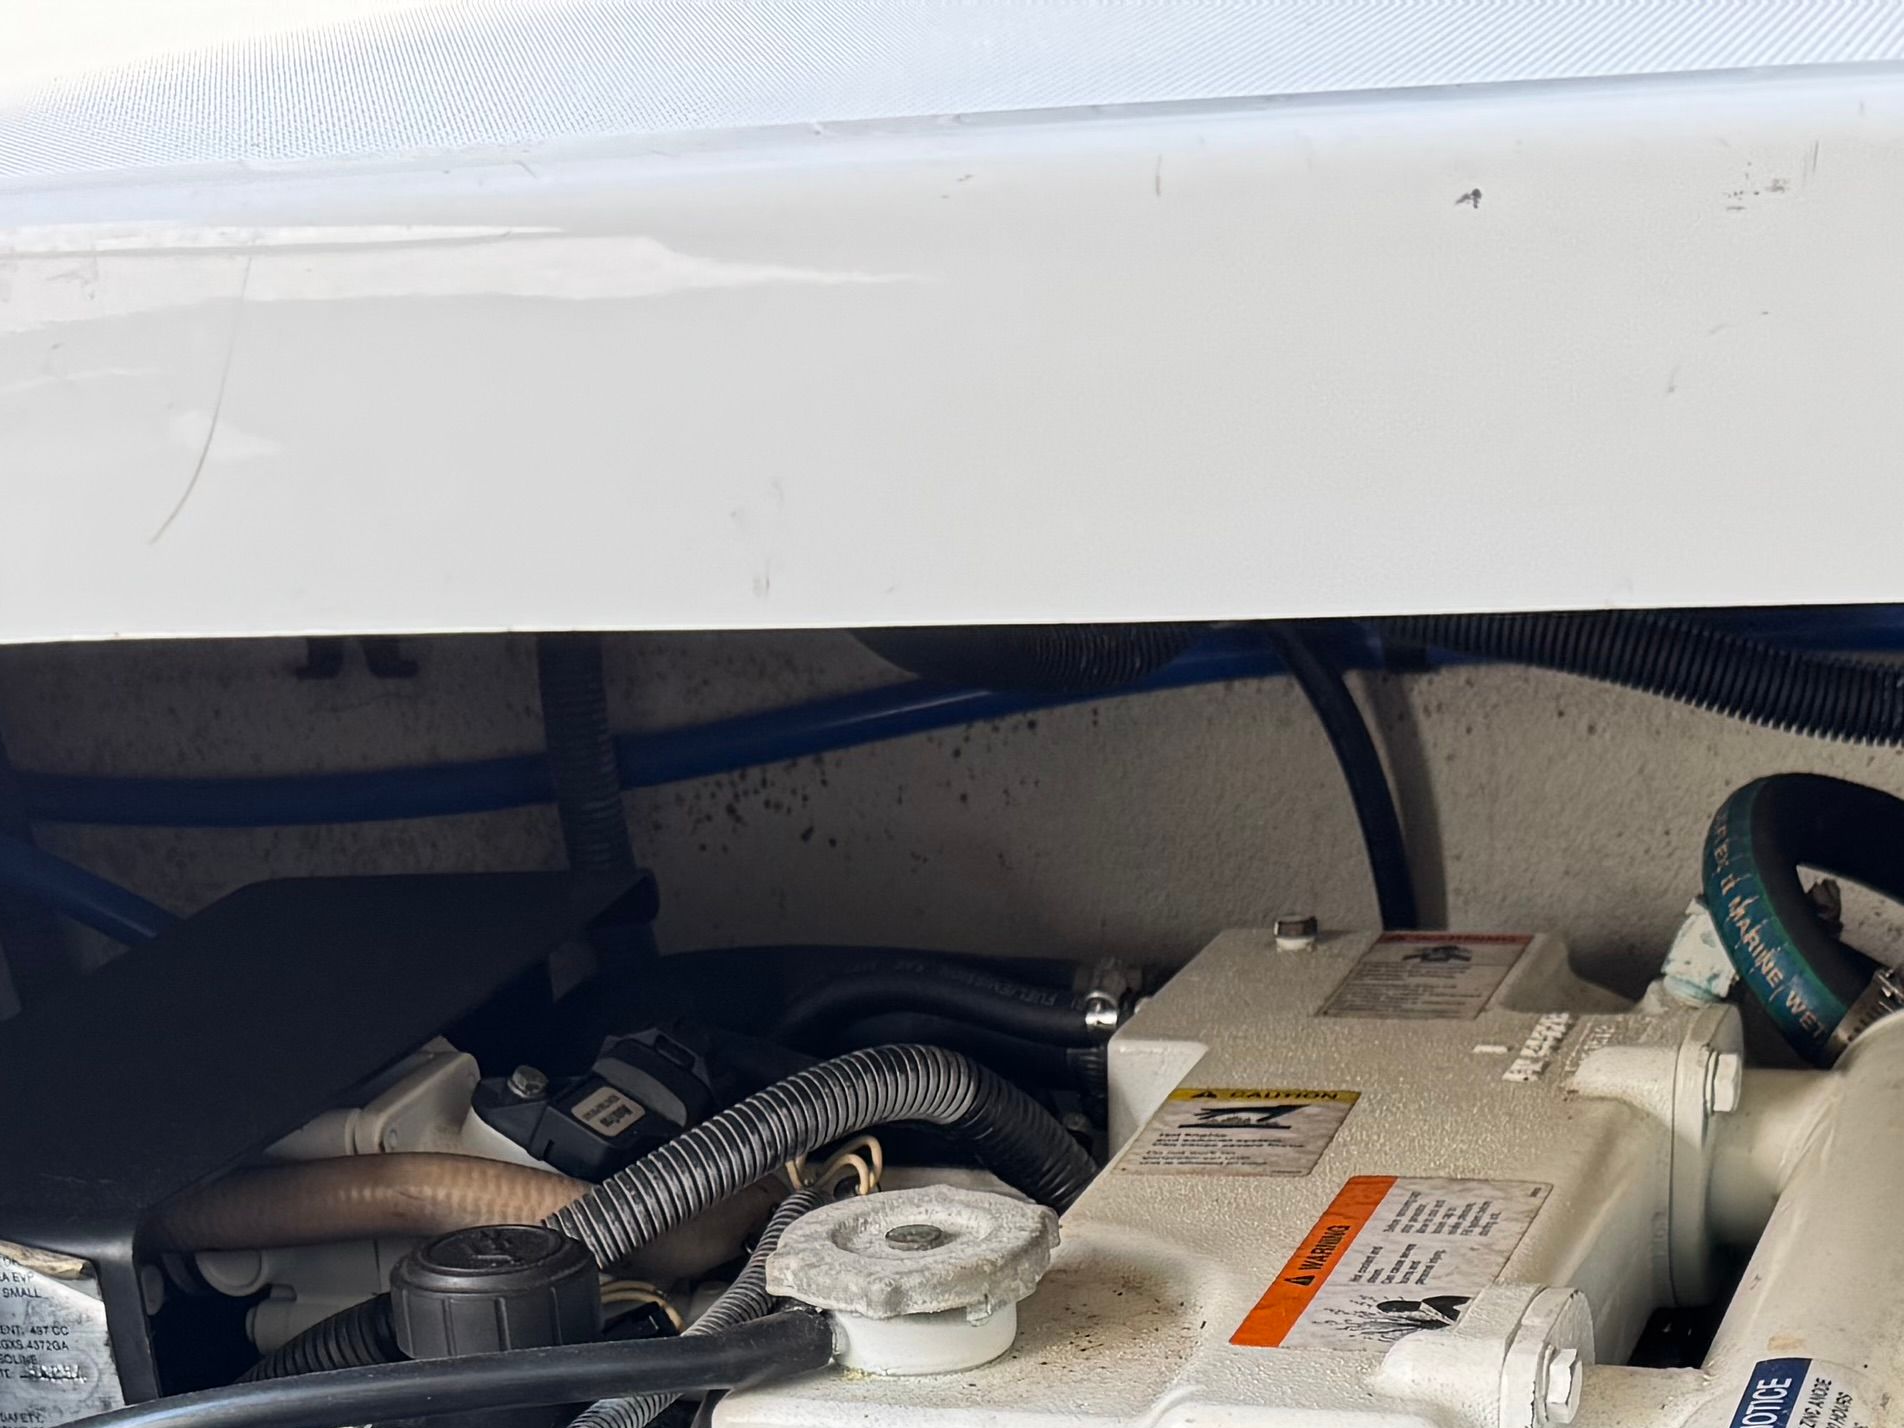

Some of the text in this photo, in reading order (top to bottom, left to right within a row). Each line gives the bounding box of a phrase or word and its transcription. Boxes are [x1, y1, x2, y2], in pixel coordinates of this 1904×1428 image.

[1230, 1091, 1338, 1100] CAUTION
[1299, 1225, 1350, 1270] WARNING
[1810, 1377, 1832, 1409] ANODE
[1834, 1391, 1854, 1424] HOURS
